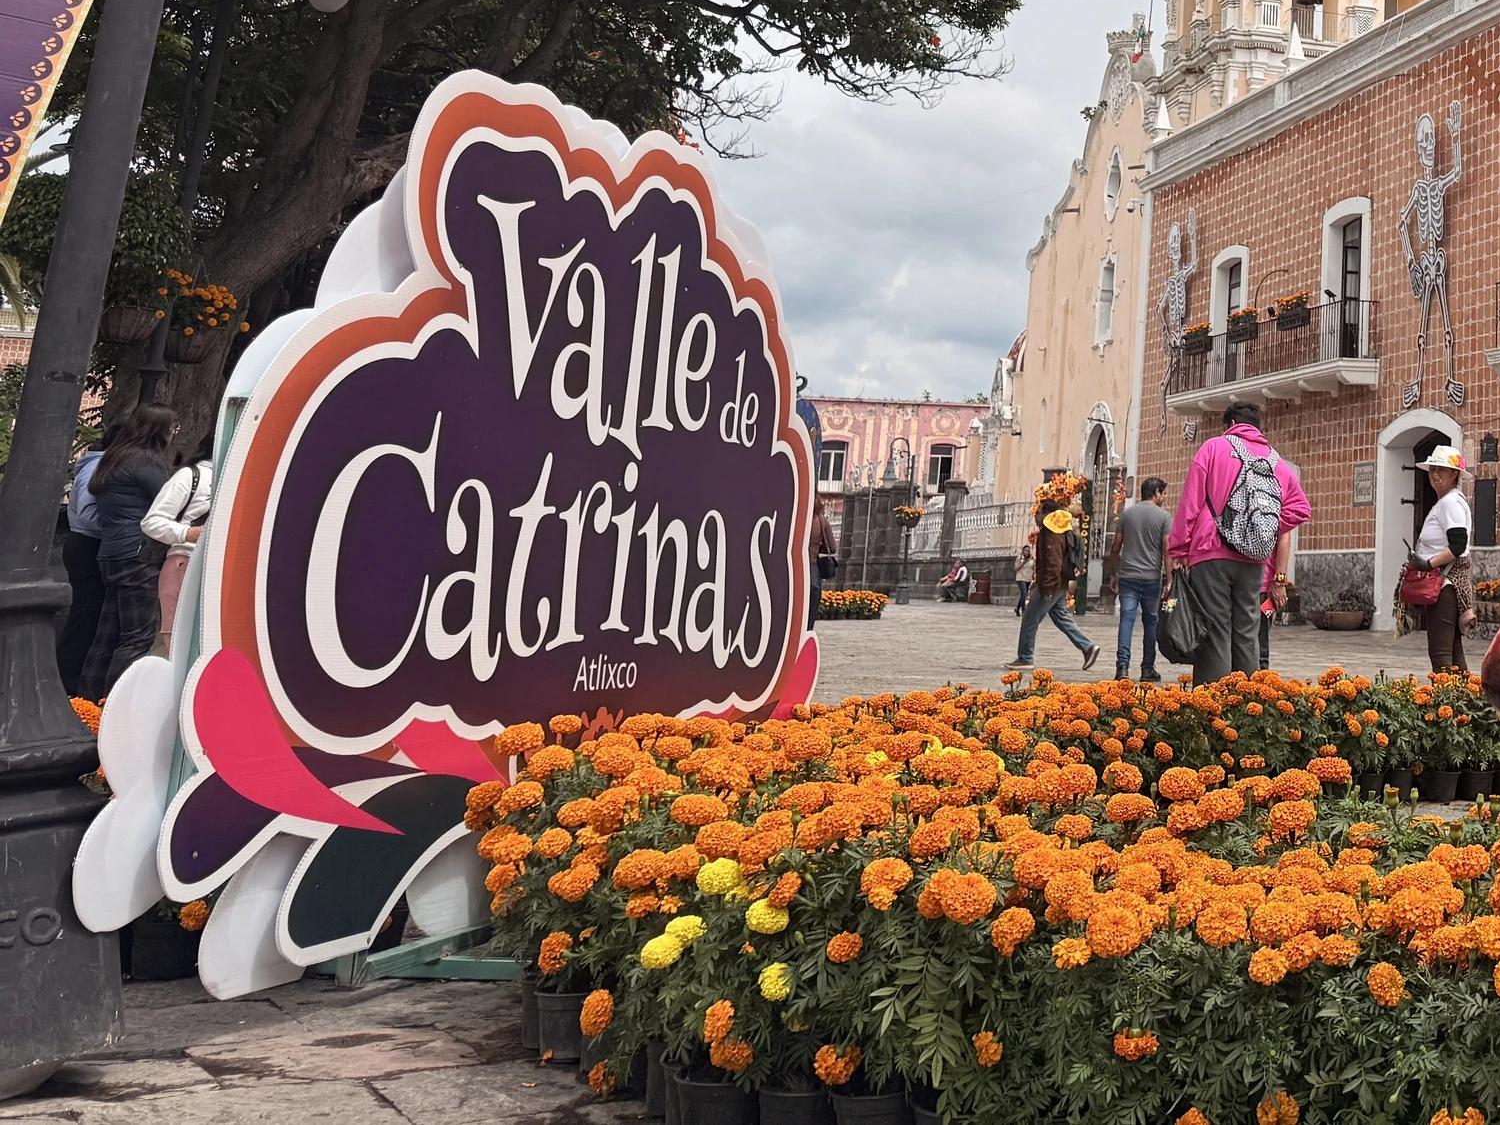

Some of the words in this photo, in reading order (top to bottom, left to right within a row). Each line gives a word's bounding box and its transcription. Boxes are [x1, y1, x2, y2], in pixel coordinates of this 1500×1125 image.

[477, 194, 716, 461] Valle
[720, 350, 759, 448] de
[306, 411, 778, 687] Catrinas
[572, 653, 638, 692] Atlixco
